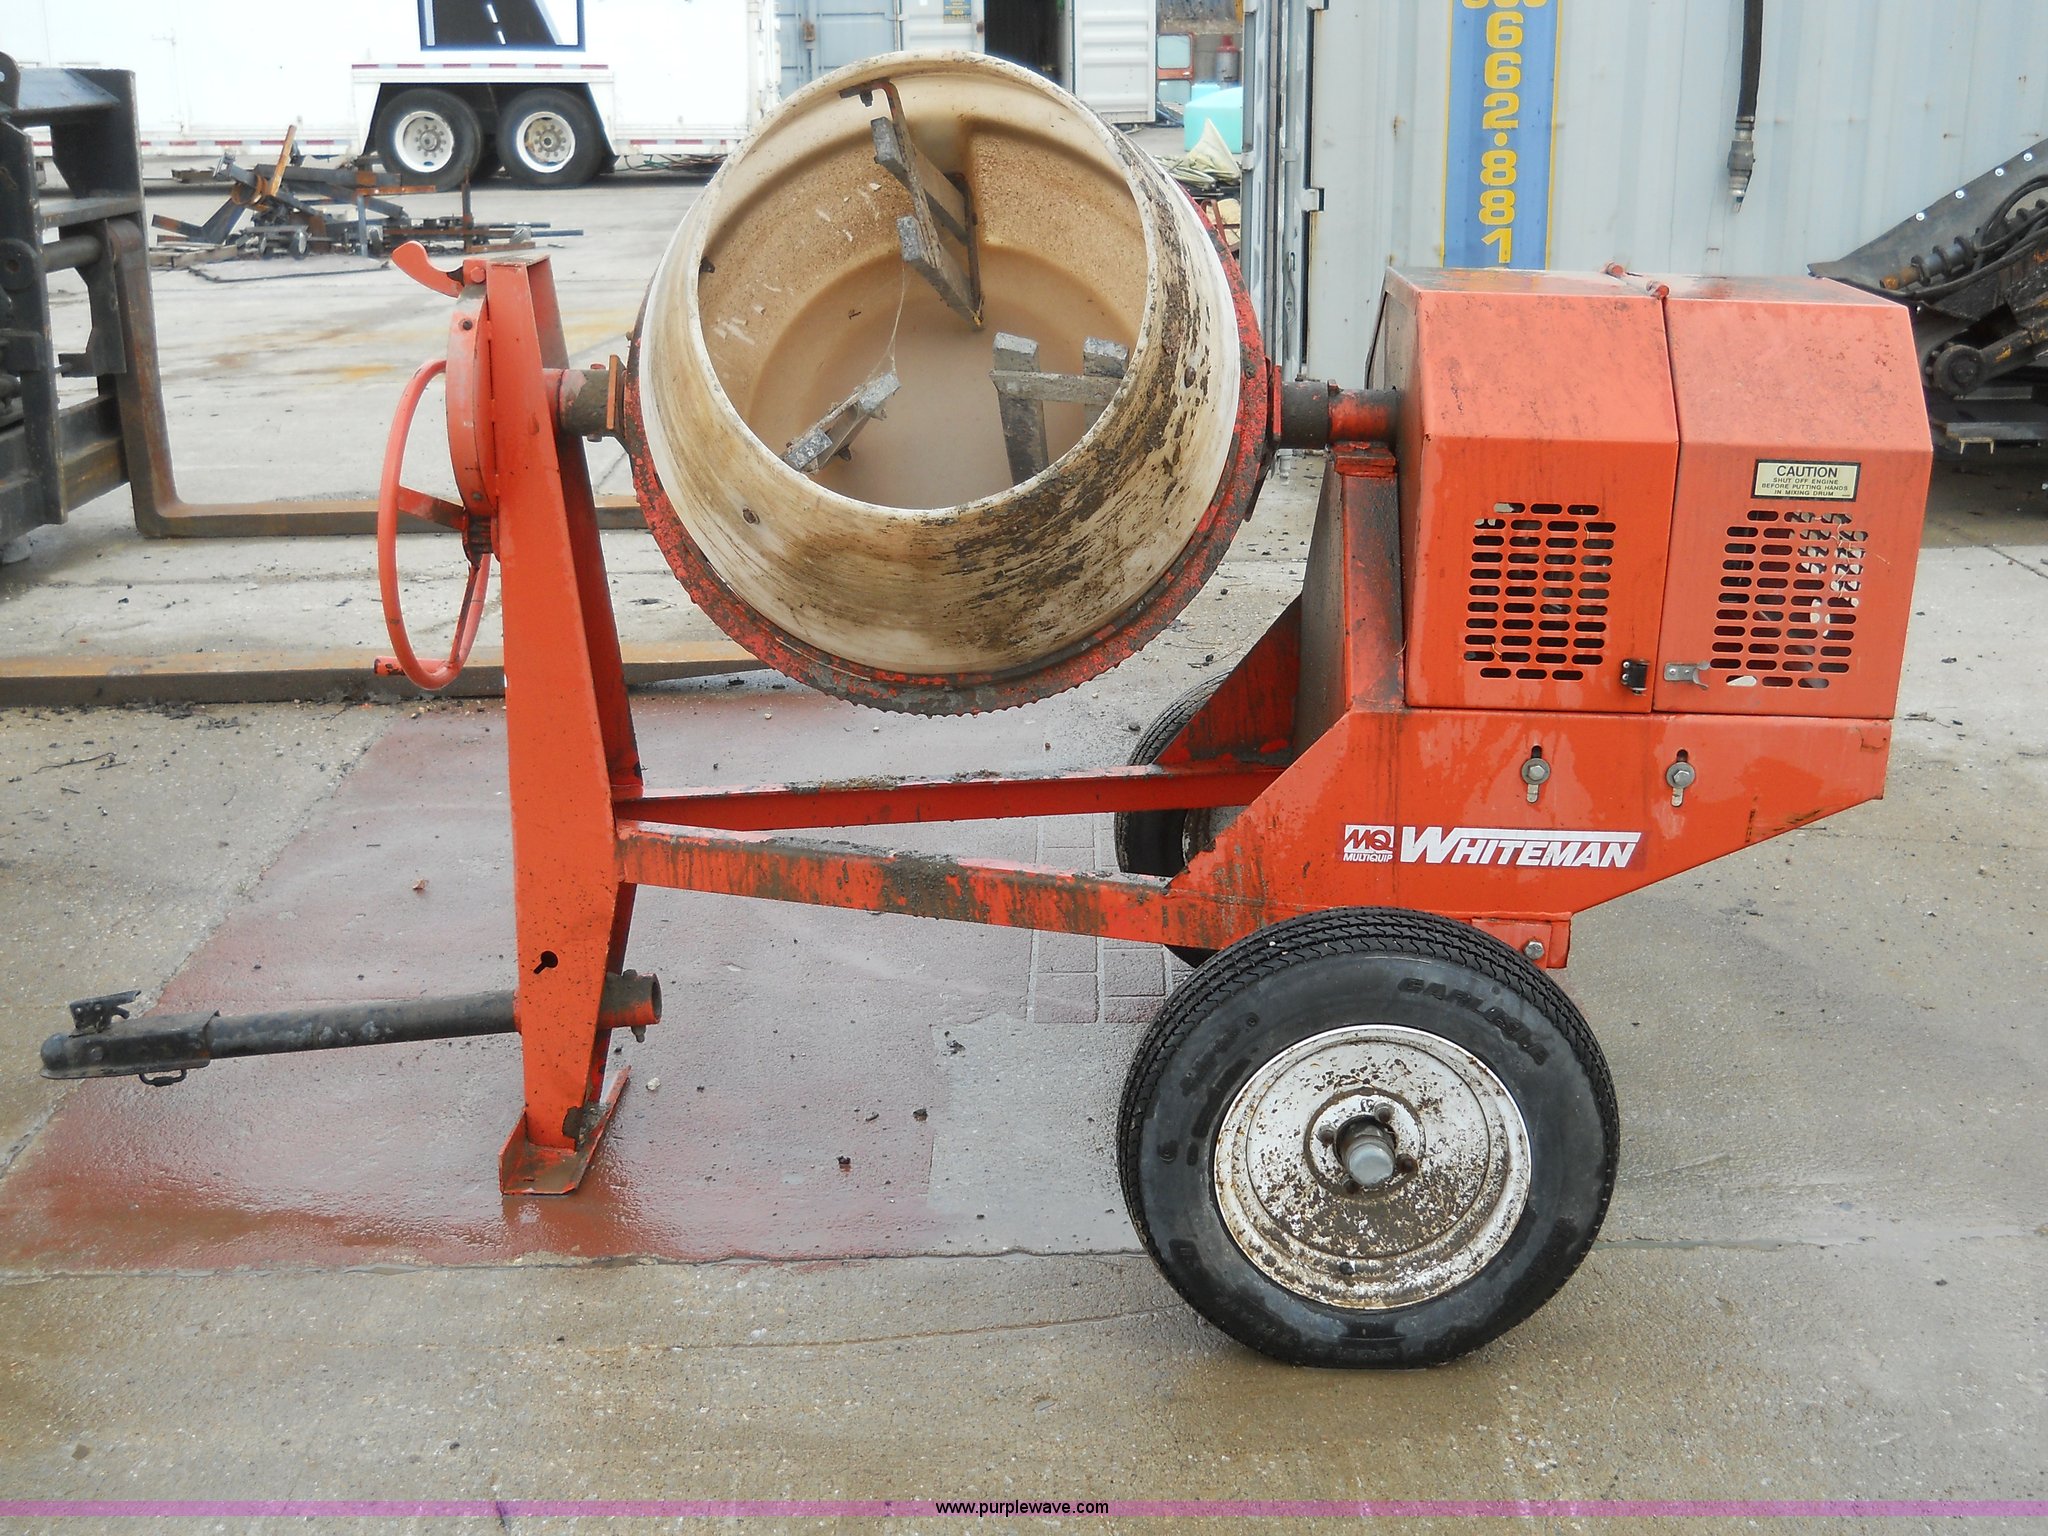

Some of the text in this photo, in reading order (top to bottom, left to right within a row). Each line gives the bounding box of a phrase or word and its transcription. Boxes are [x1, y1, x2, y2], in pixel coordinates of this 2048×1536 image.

[1776, 465, 1838, 478] CAUTION
[1344, 828, 1394, 851] MQ
[1400, 826, 1641, 868] WHITEMAN
[1343, 853, 1393, 863] MULTIQUIP
